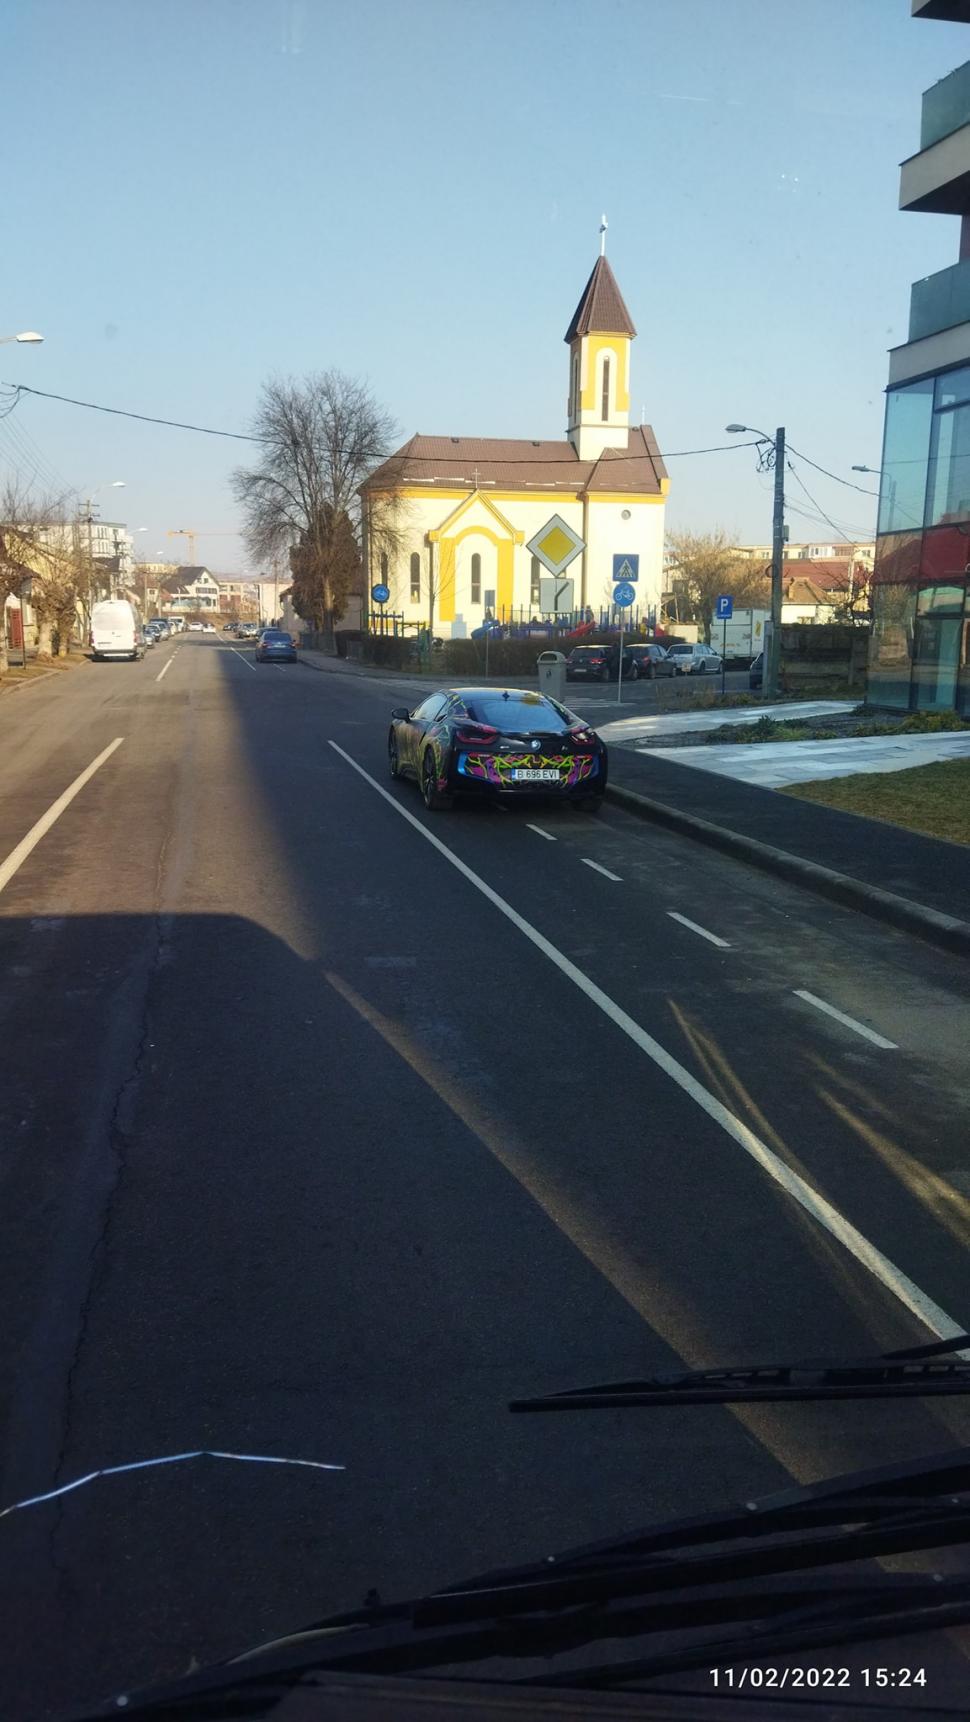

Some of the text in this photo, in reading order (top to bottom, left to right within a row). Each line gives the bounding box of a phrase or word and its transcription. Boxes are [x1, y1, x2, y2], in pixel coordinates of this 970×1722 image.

[720, 598, 729, 613] P
[517, 770, 557, 779] B 696 EVI
